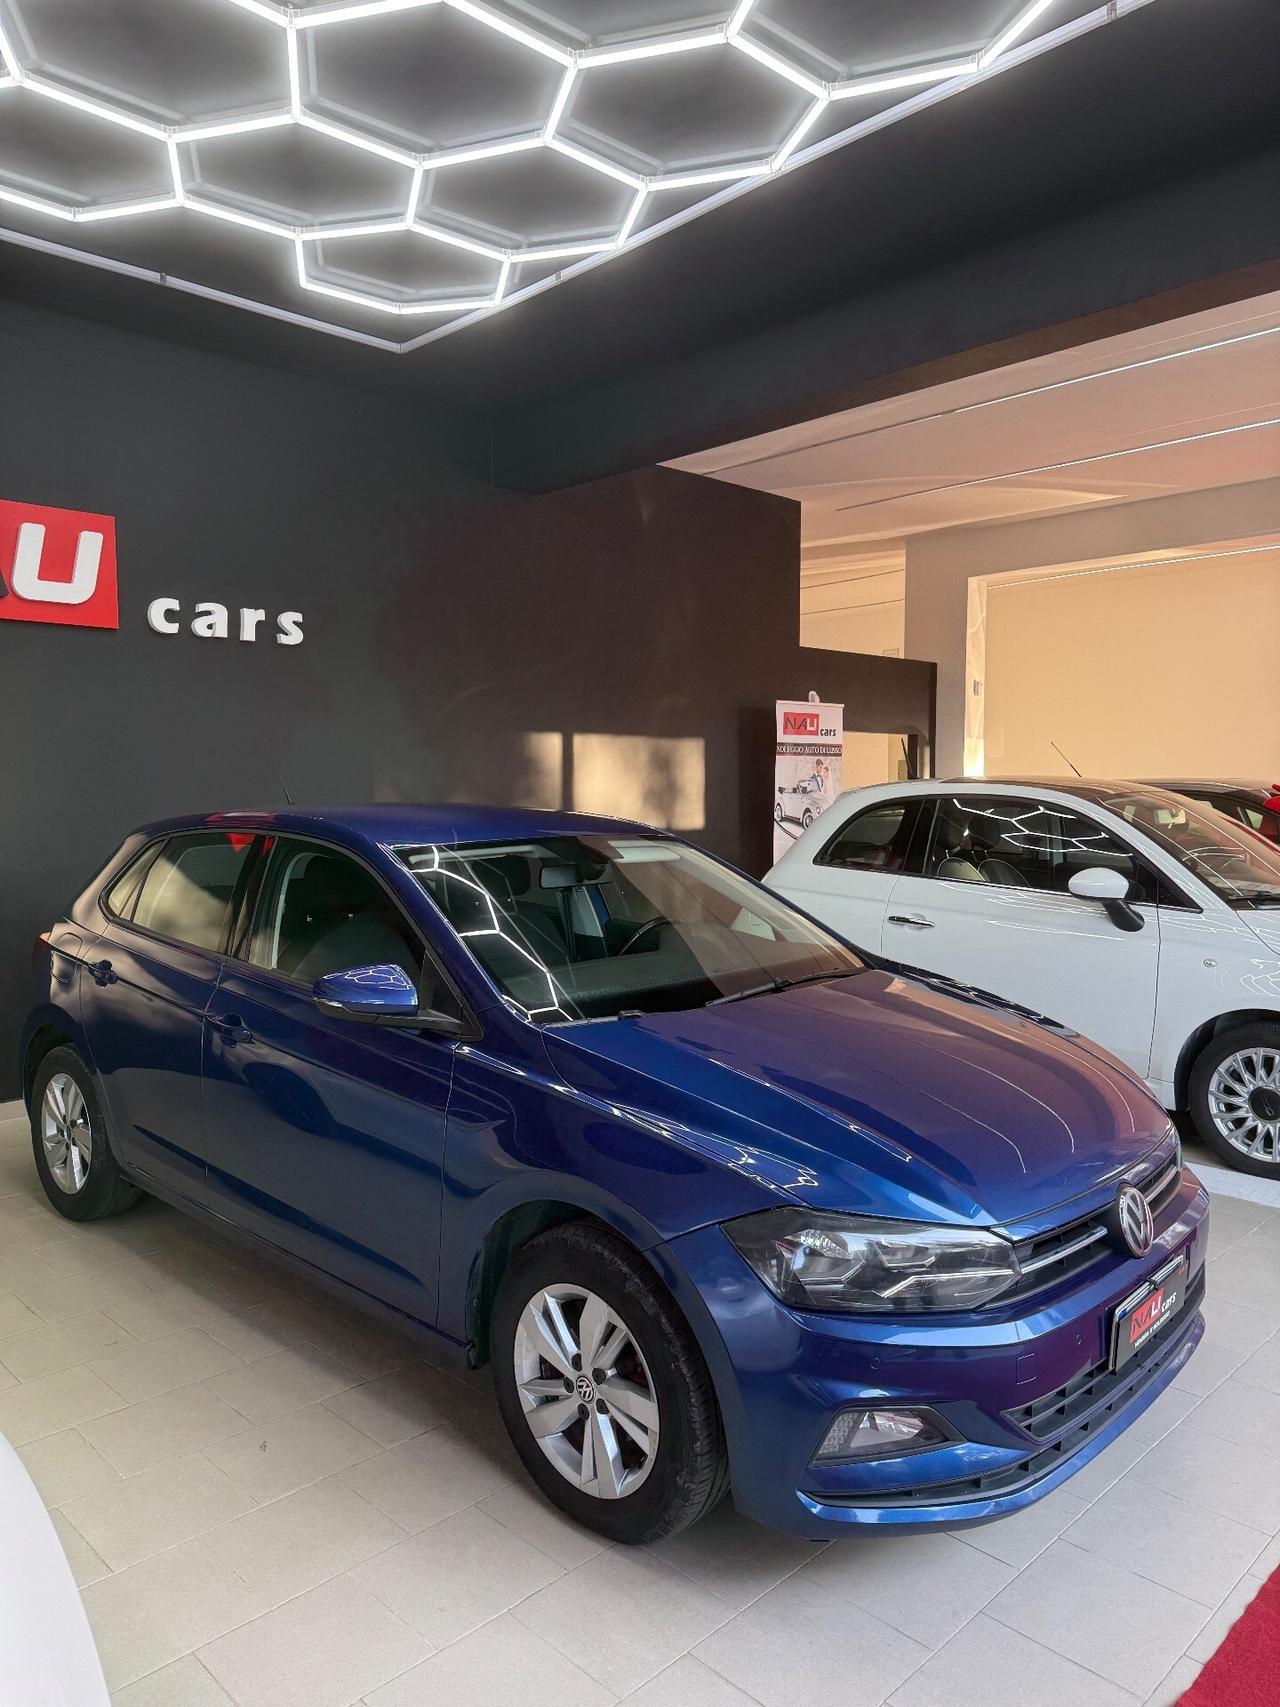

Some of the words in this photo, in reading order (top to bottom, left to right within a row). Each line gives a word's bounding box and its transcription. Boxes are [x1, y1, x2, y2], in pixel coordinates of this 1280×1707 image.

[147, 597, 304, 646] cars
[820, 728, 837, 737] cars
[804, 746, 819, 754] AUTO
[1161, 1291, 1177, 1313] cars
